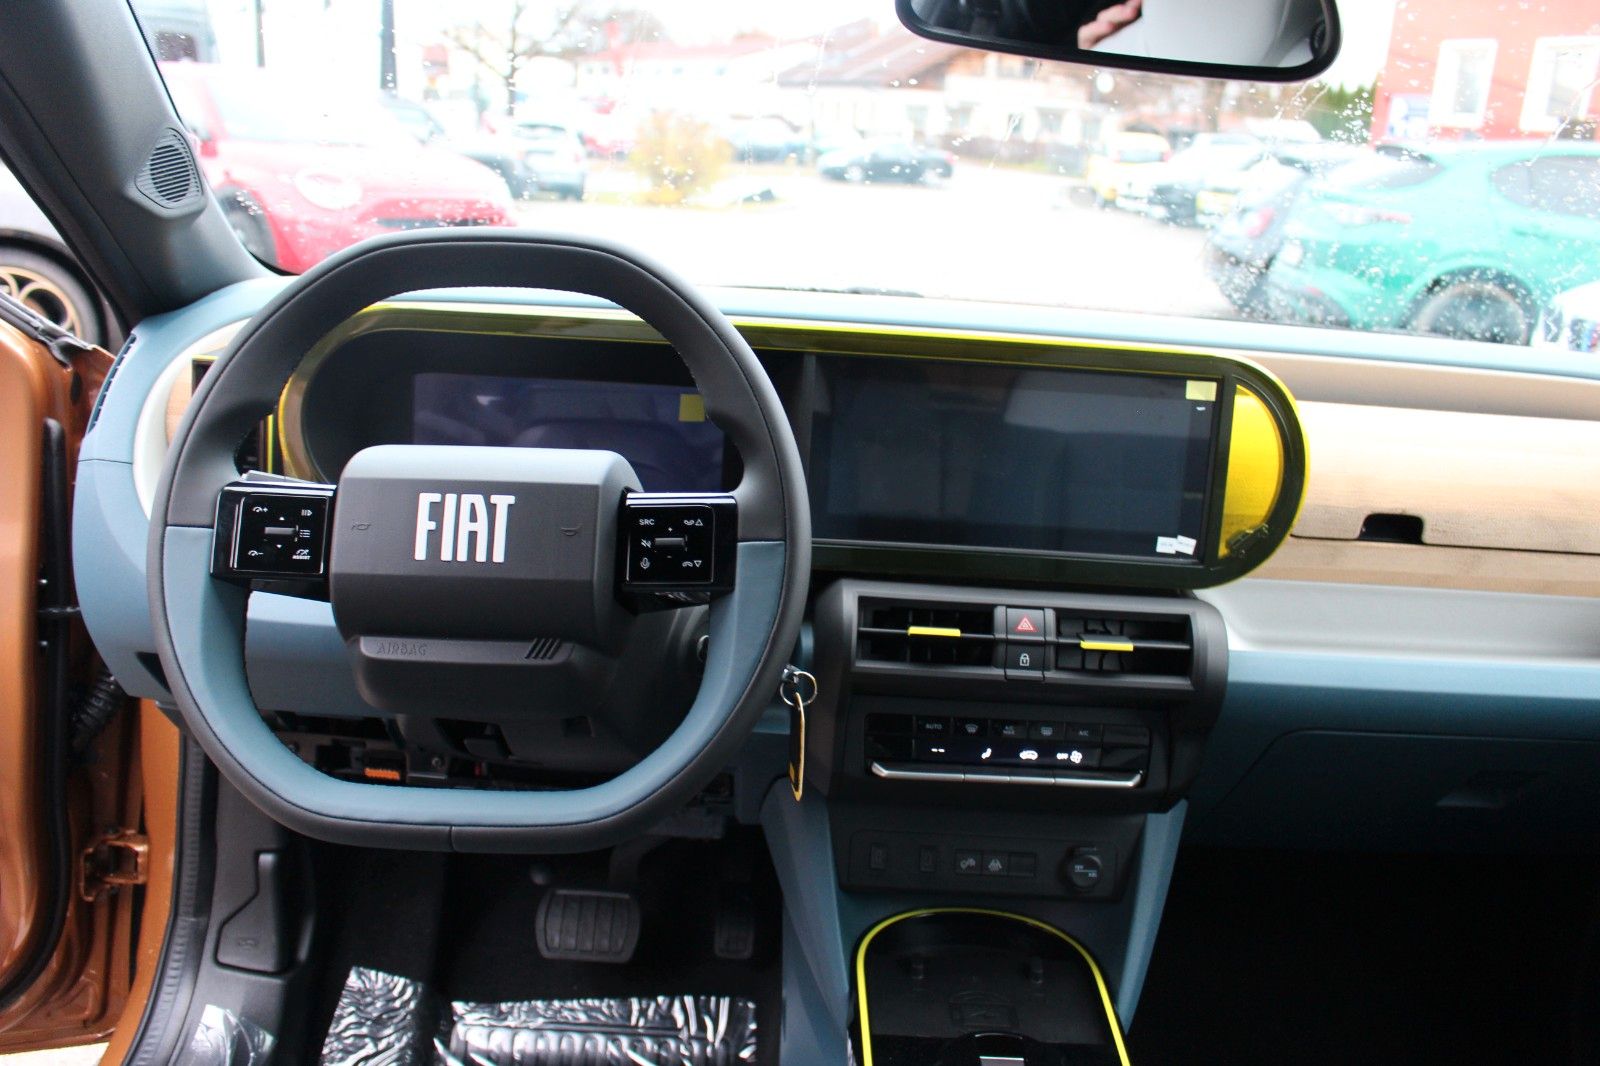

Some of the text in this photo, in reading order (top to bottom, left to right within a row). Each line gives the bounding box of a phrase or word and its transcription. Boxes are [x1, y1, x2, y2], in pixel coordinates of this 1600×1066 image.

[414, 492, 516, 563] FIAT
[638, 518, 655, 526] SRC
[376, 642, 428, 656] AIRBAG
